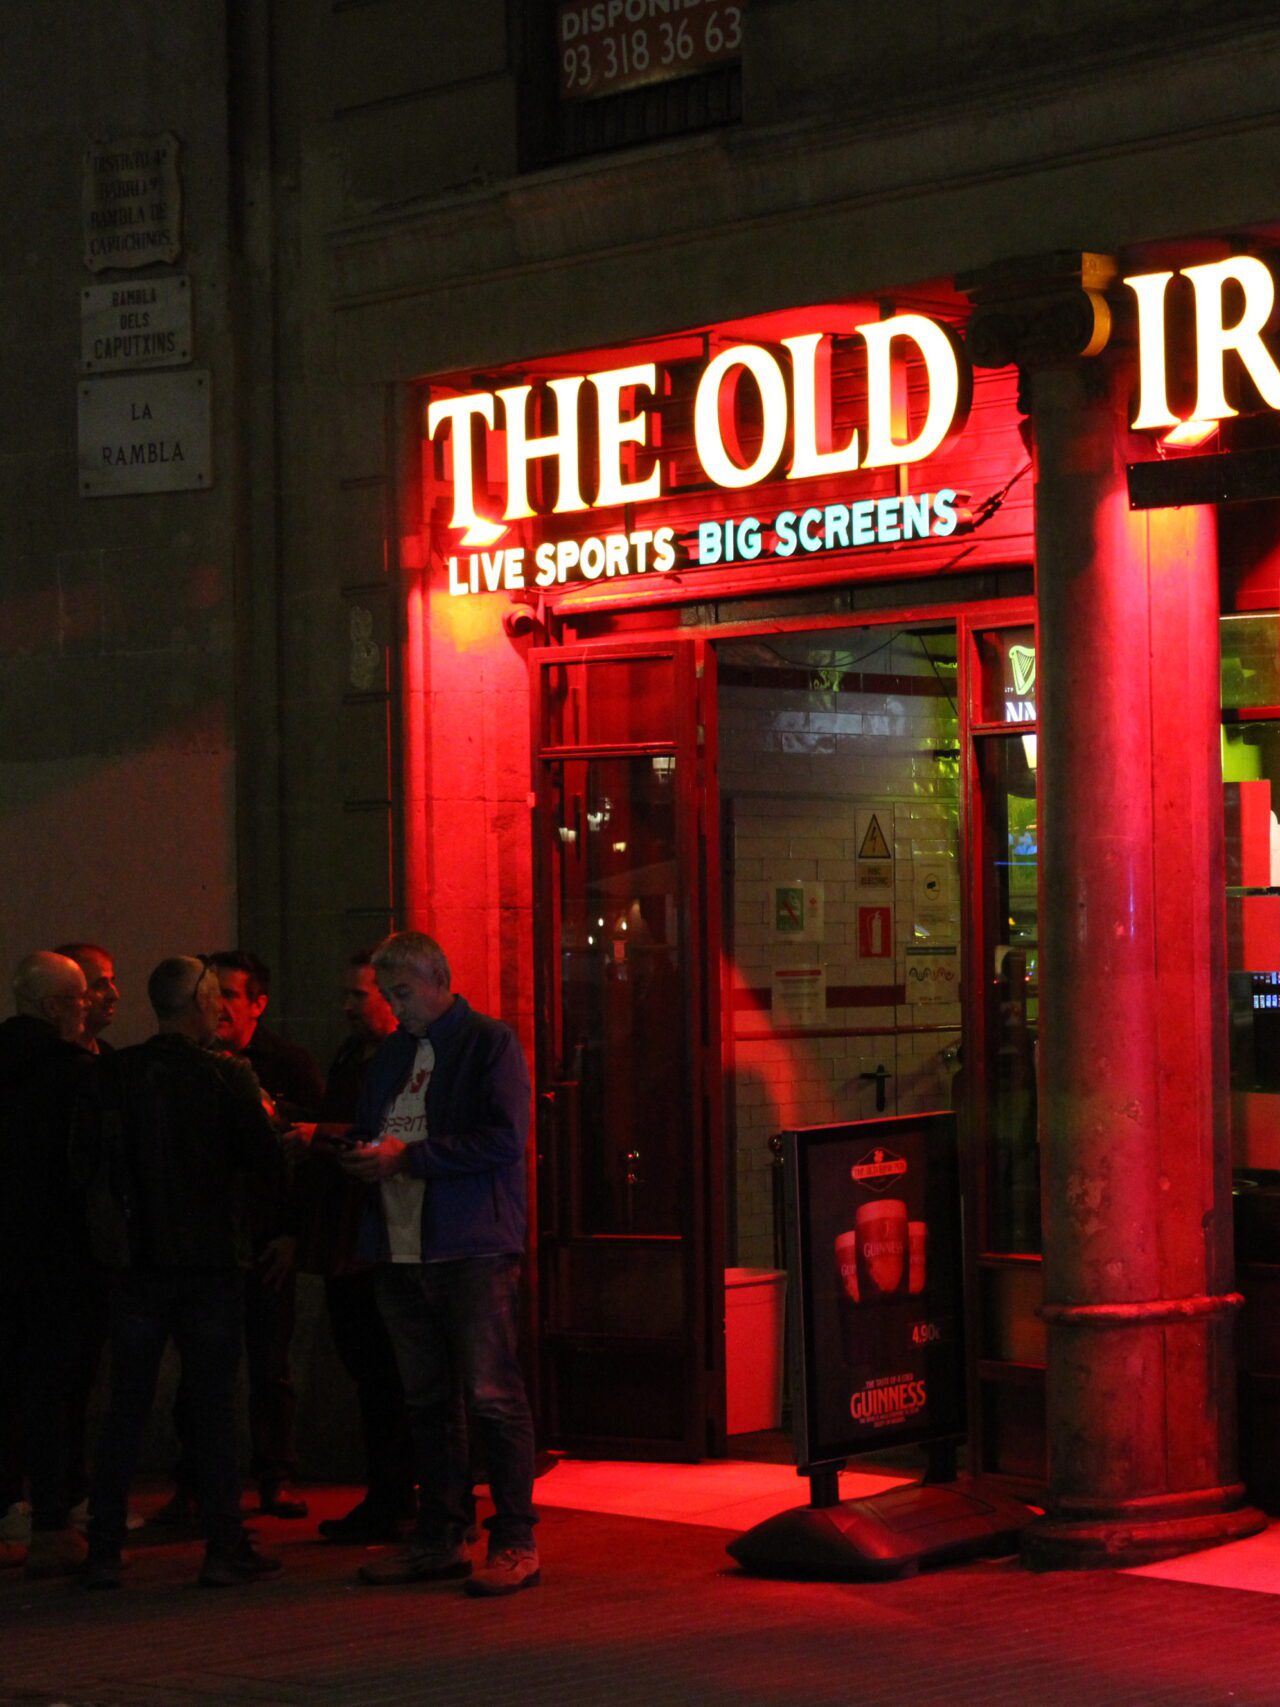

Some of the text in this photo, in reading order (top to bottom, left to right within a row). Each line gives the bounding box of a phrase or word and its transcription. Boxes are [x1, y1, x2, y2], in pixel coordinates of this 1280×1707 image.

[562, 0, 717, 41] DISPON
[563, 7, 743, 89] 93 318 36 63
[90, 206, 145, 227] RAMBLA
[112, 287, 157, 307] RAMBLA
[120, 312, 150, 330] DELS
[94, 332, 175, 360] CAPUTXINS
[130, 402, 152, 421] LA
[428, 314, 958, 529] THE OLD
[101, 441, 185, 466] RAMBLA
[448, 488, 958, 596] LIVE SPORTS BIG SCREENS
[850, 1379, 927, 1419] GUINNESS
